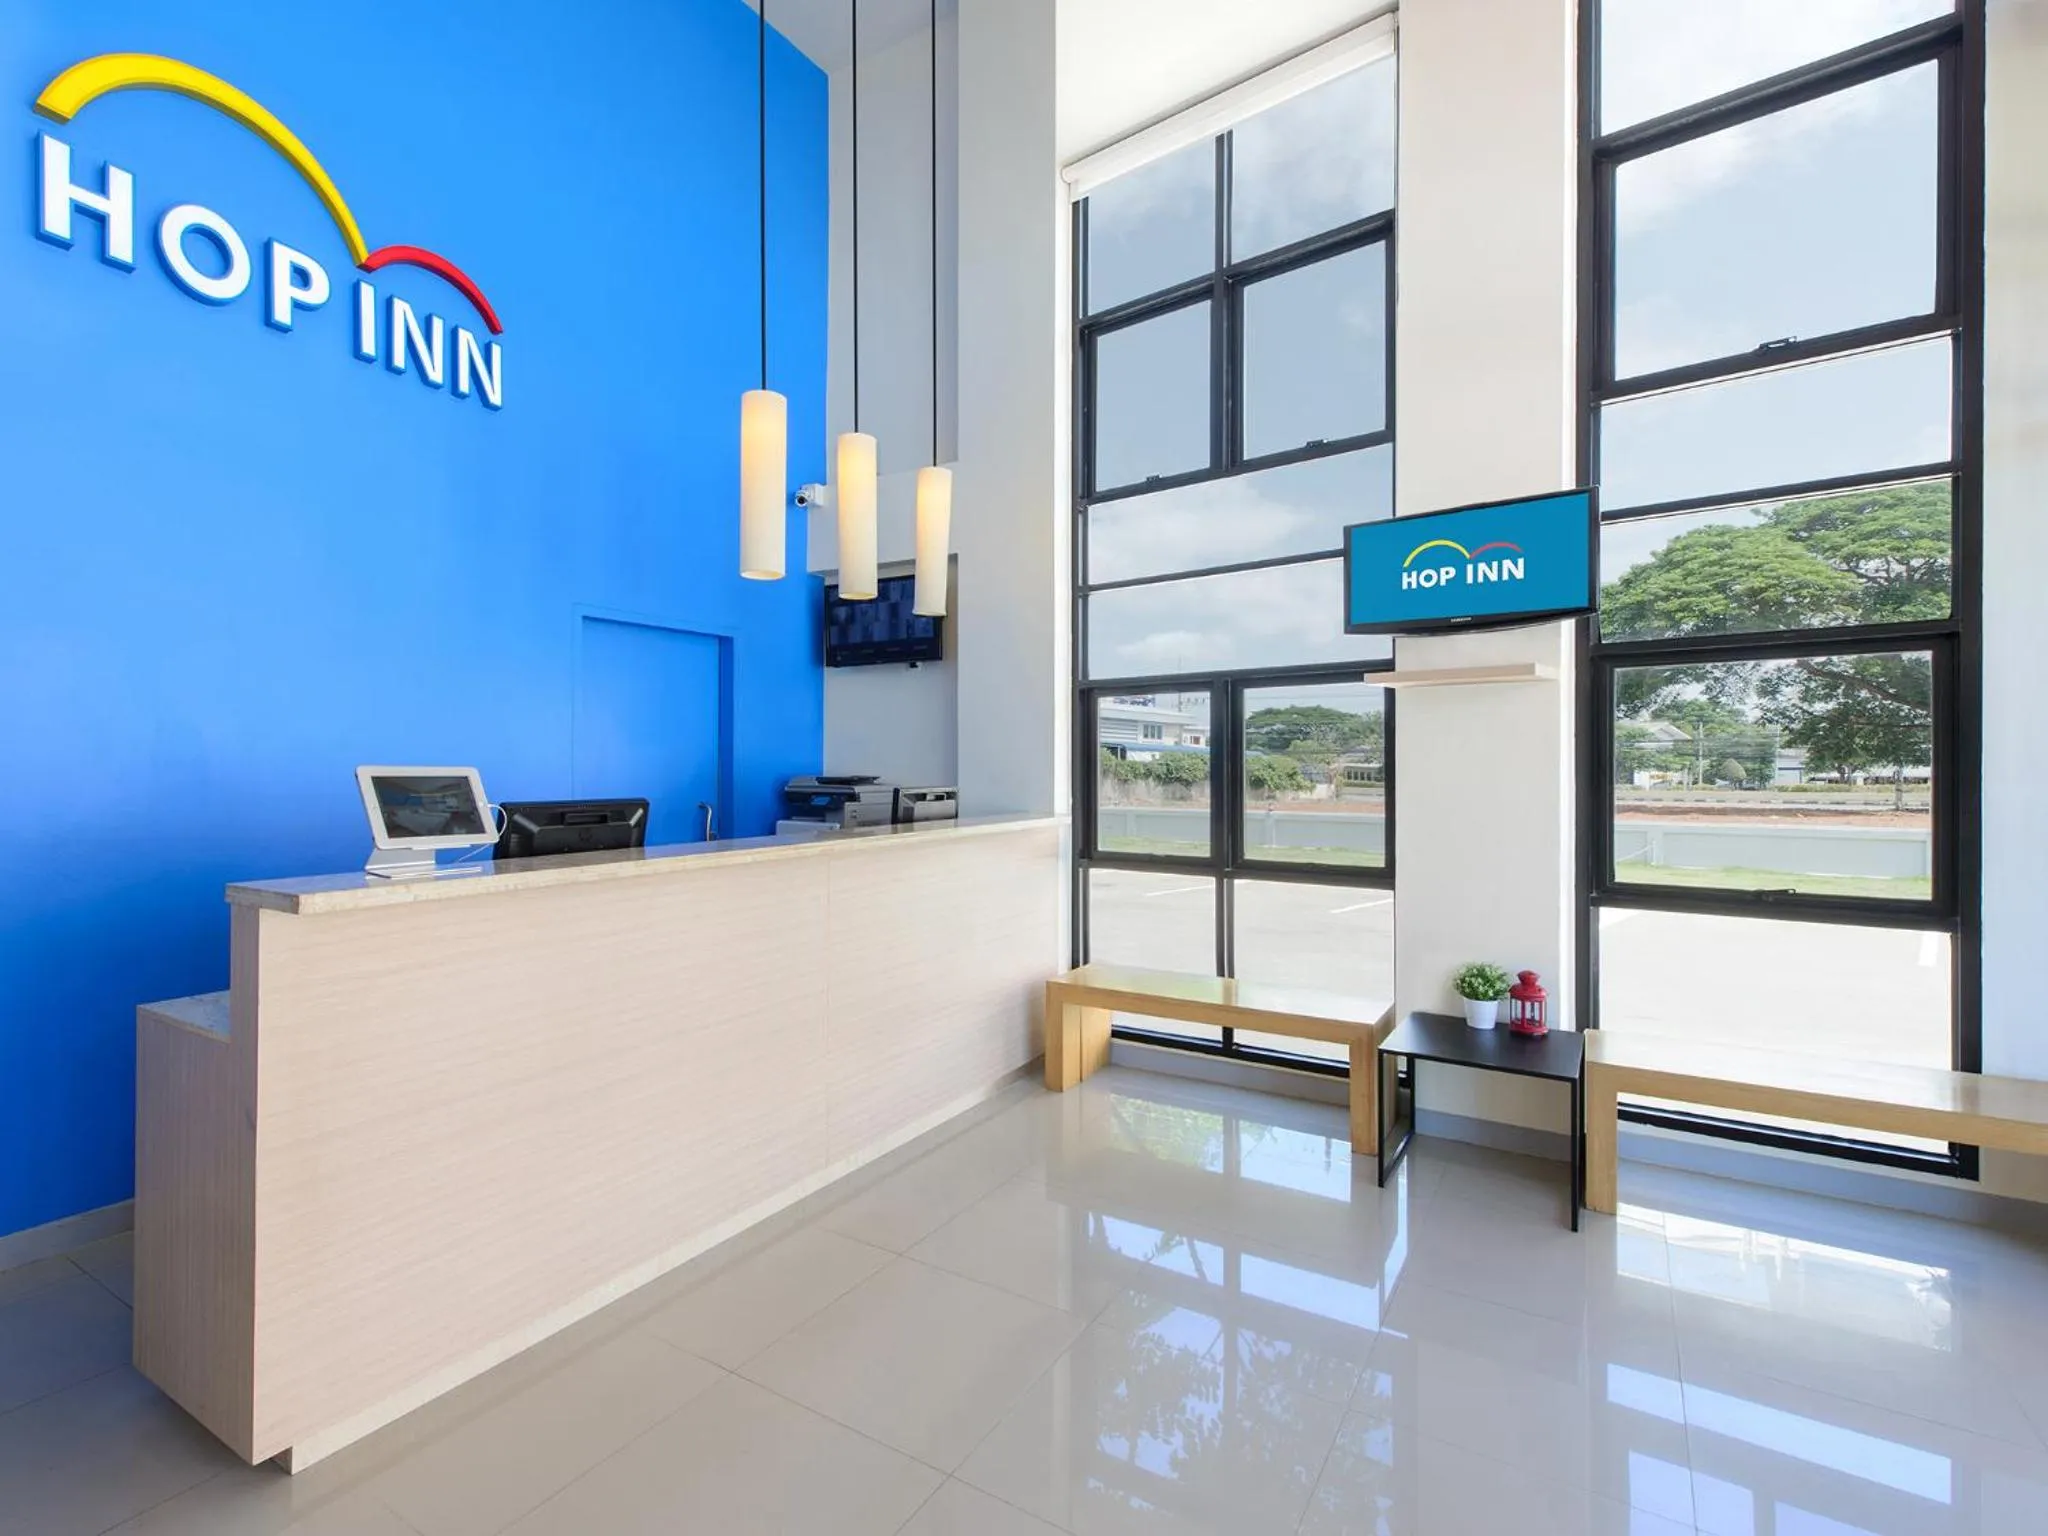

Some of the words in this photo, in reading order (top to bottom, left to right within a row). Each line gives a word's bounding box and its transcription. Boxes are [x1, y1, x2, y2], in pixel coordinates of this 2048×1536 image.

[36, 131, 331, 332] HOP
[353, 278, 502, 411] INN
[1402, 567, 1456, 590] HOP
[1466, 557, 1524, 584] INN
